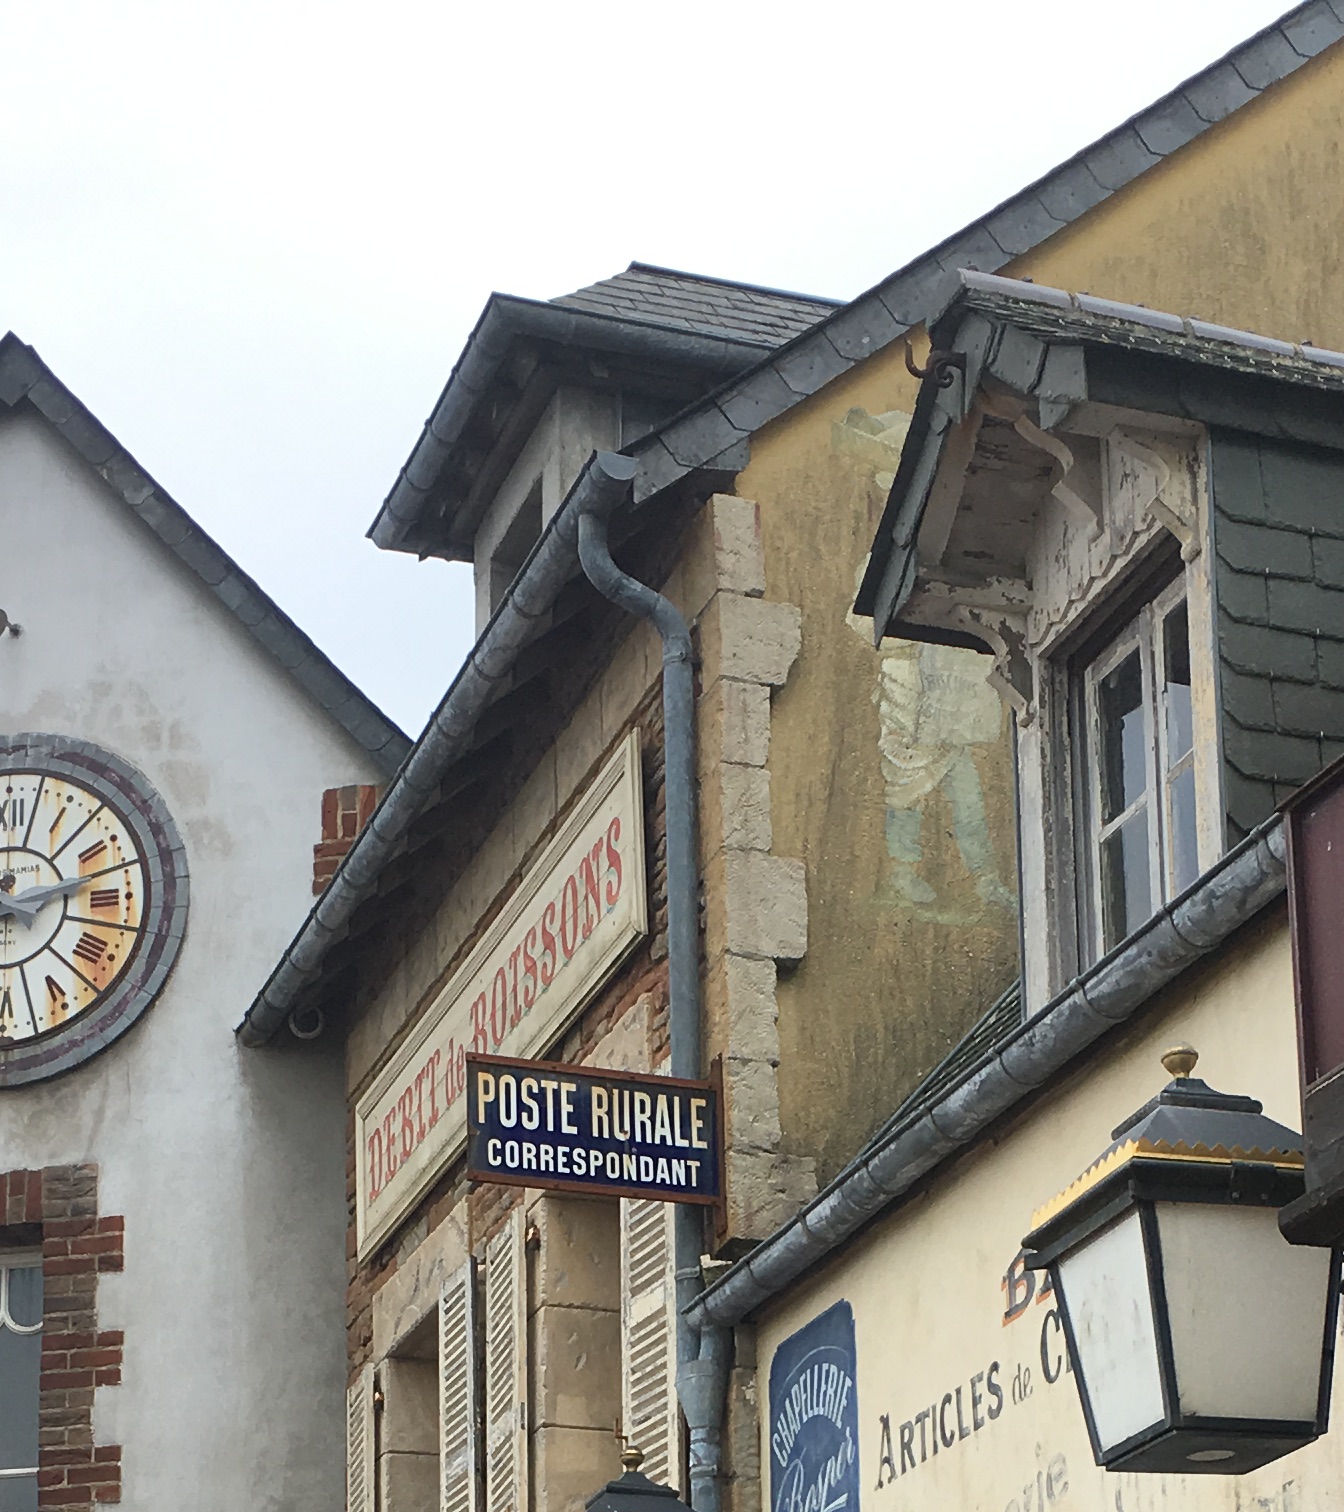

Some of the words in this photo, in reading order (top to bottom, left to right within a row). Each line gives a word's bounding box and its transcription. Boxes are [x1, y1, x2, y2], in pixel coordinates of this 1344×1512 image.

[78, 840, 107, 864] II
[90, 888, 119, 908] III
[45, 975, 67, 1003] V
[368, 1048, 441, 1201] DEBIT
[445, 1037, 465, 1107] de
[468, 816, 624, 1056] BOISSONS
[477, 1071, 578, 1136] POSTE
[591, 1086, 708, 1149] RURALE
[487, 1138, 701, 1187] CORRESPONDANT
[1012, 1363, 1034, 1405] de
[772, 1362, 853, 1468] CHAPELLERIE
